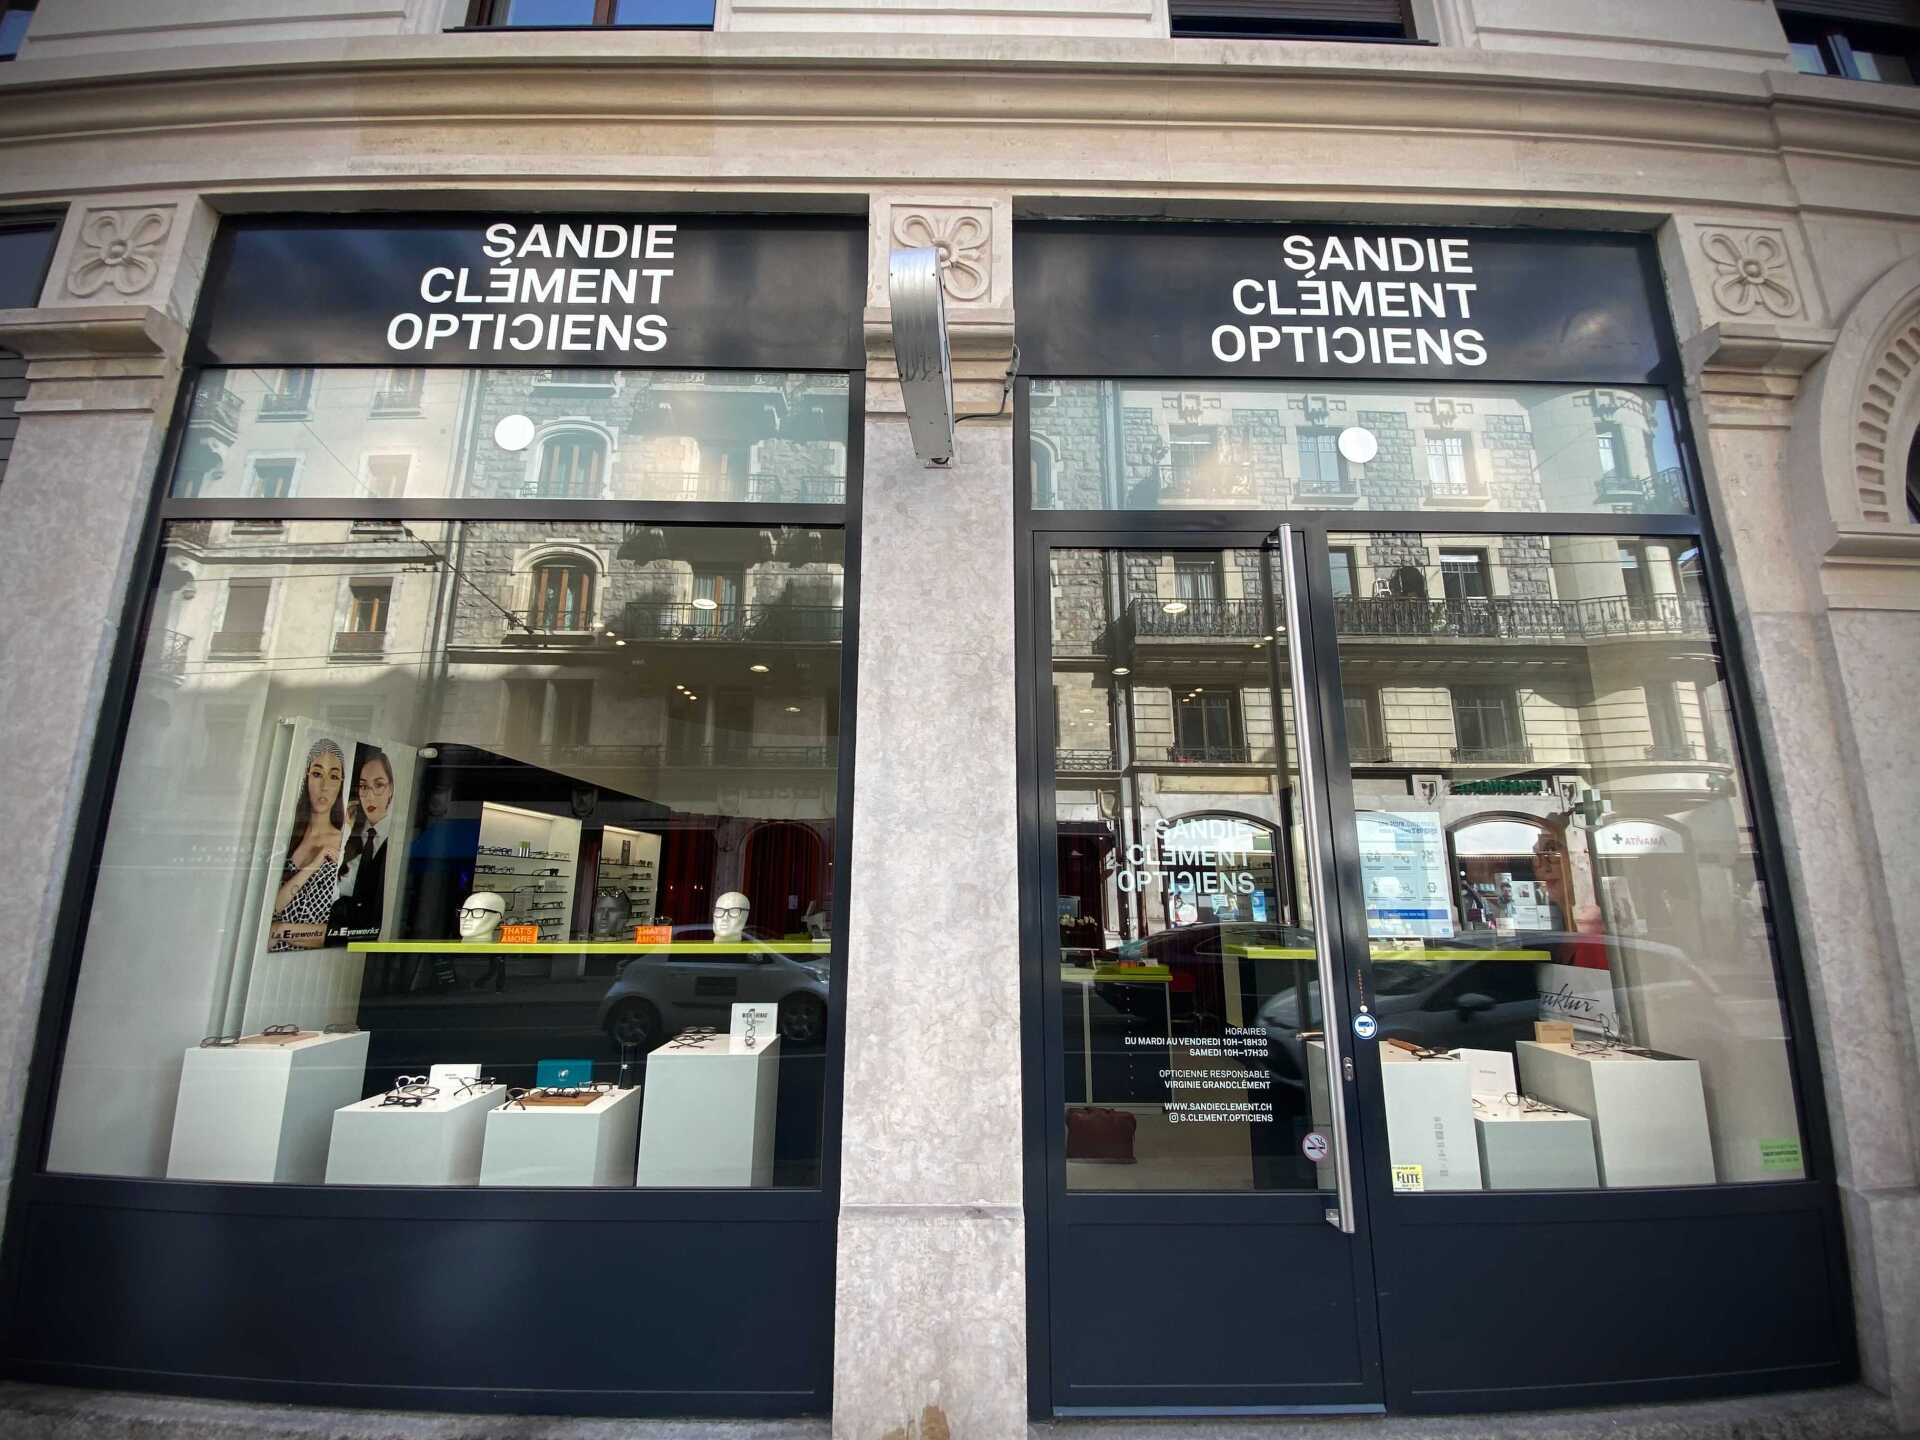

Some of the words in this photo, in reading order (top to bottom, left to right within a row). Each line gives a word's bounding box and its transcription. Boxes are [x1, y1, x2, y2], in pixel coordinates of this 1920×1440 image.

[482, 223, 677, 259] SANDIE
[1283, 235, 1473, 273] SANDIE
[1225, 1027, 1267, 1036] HORAIRES
[1124, 1037, 1137, 1045] DU
[1138, 1037, 1166, 1046] MARDI
[1166, 1037, 1179, 1046] AU
[1179, 1038, 1221, 1046] VENDREDI
[1189, 1048, 1222, 1057] SAMEDI
[1159, 1069, 1209, 1078] OPTICIENNE
[1210, 1070, 1271, 1079] RESPONSABLE
[1164, 1080, 1201, 1089] VIRGINIE
[1202, 1080, 1271, 1090] GRANDCLÉMENT
[1164, 1102, 1273, 1112] WWW.SANDIECLEMENT.CH
[1179, 1113, 1274, 1123] S.CLEMENT.OPTICIENS
